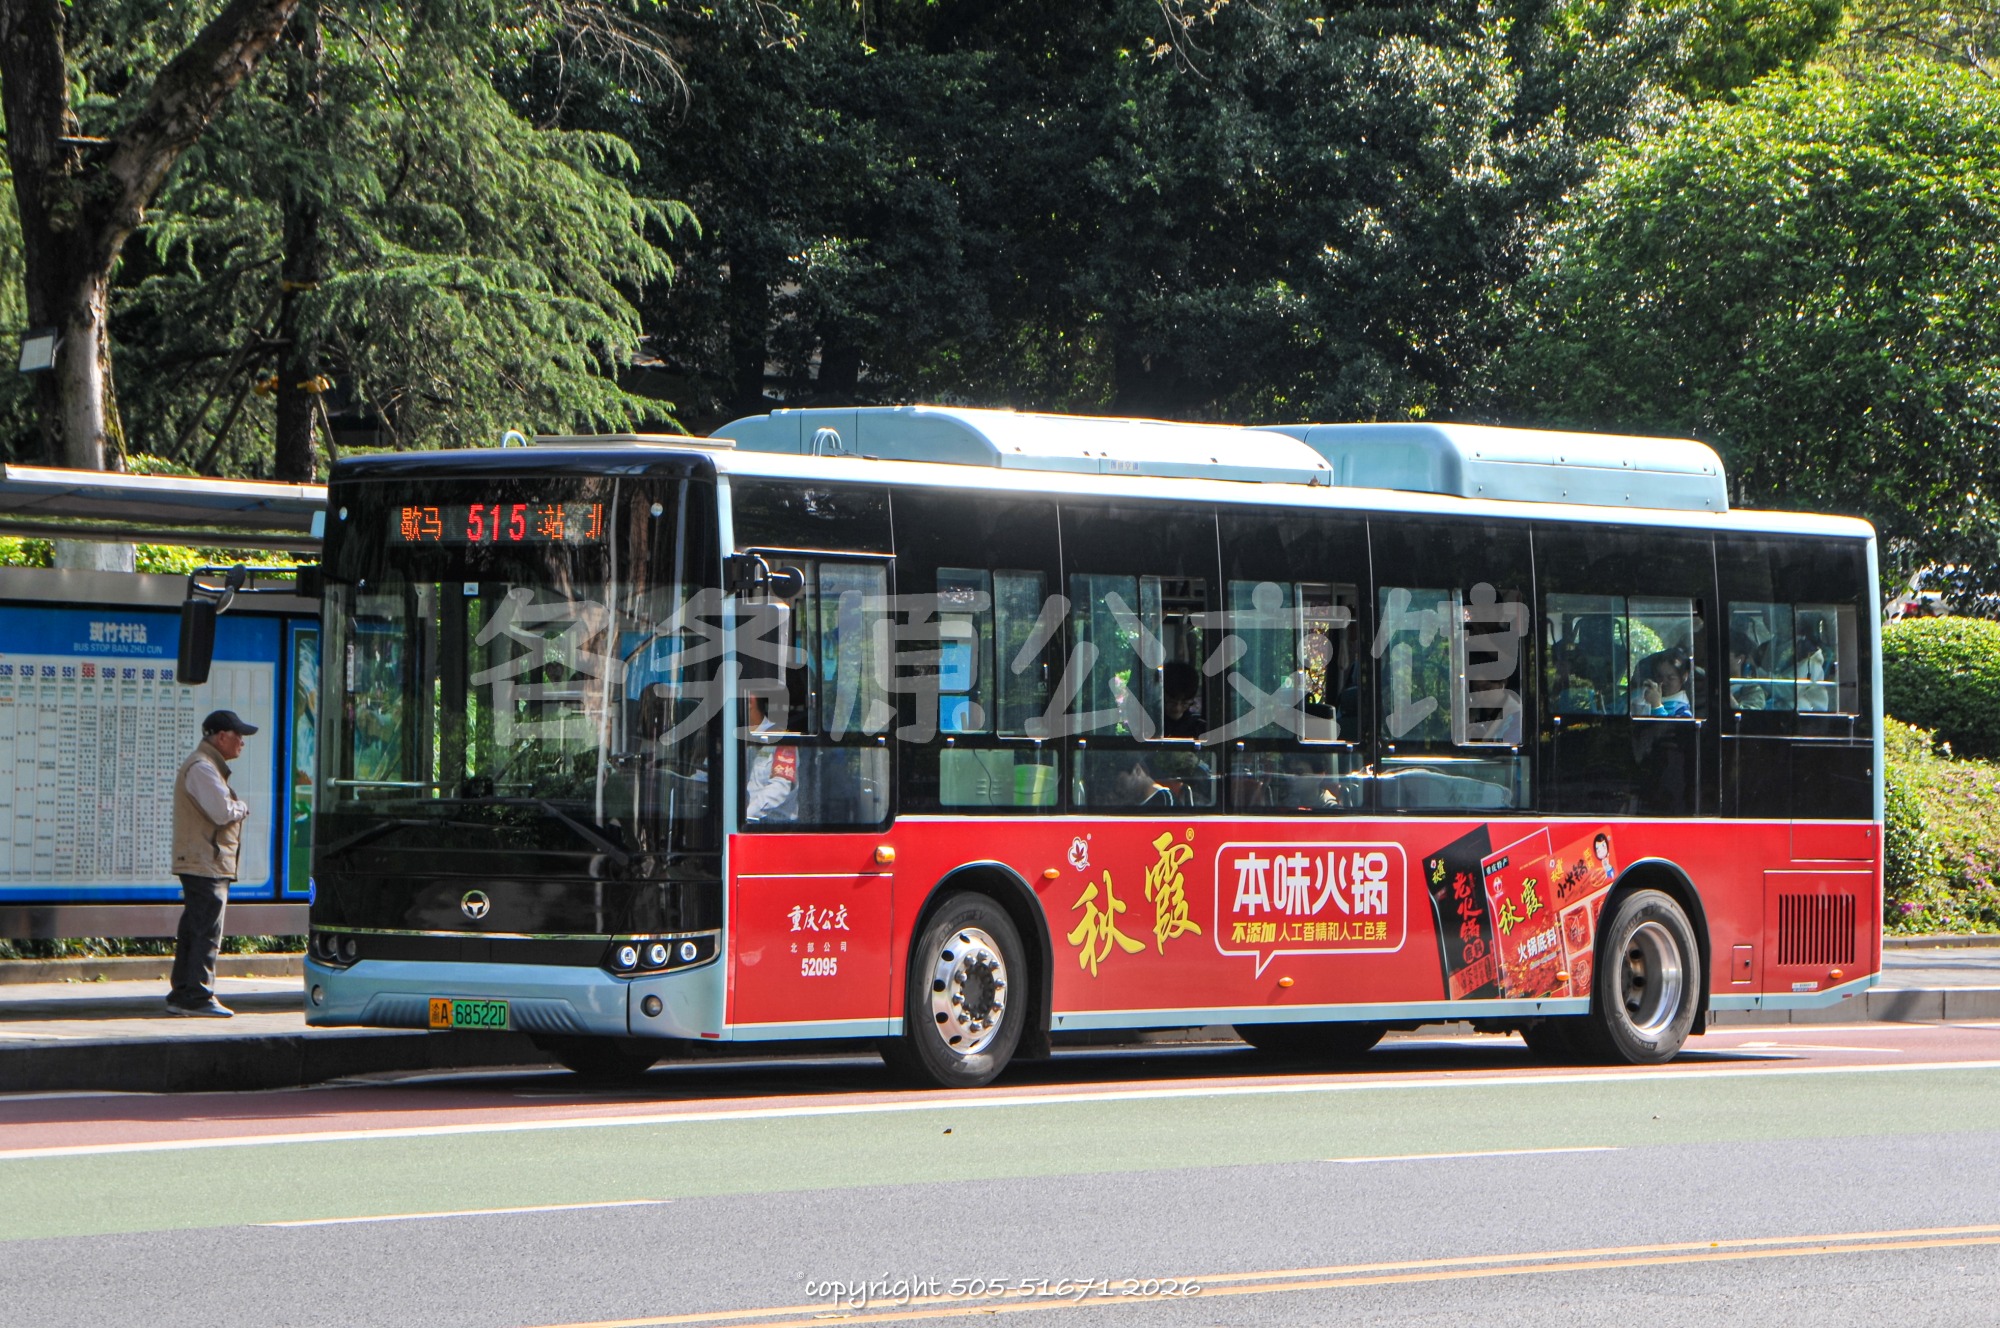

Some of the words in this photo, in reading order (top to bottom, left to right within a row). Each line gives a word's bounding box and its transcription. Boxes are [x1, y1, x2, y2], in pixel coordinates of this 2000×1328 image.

[400, 505, 442, 541] 歇马
[466, 503, 527, 541] 515
[73, 642, 89, 652] BUS
[90, 643, 110, 653] STOP
[111, 644, 129, 653] BAN
[130, 644, 145, 654] ZHU
[146, 645, 163, 654] CUN
[20, 664, 35, 677] 535
[62, 666, 76, 678] 551
[122, 668, 137, 680] 587
[1232, 851, 1388, 916] 本味火锅
[1066, 831, 1202, 978] 秋霞
[1498, 877, 1544, 936] 秋霞
[787, 904, 850, 932] 重庆公交
[1231, 922, 1276, 944] 不添加
[1278, 921, 1388, 943] 人工香精和人工色素
[790, 941, 848, 953] 北部公司
[1517, 926, 1558, 963] 火锅底料
[801, 957, 838, 977] 52095
[455, 1003, 507, 1026] 68522D
